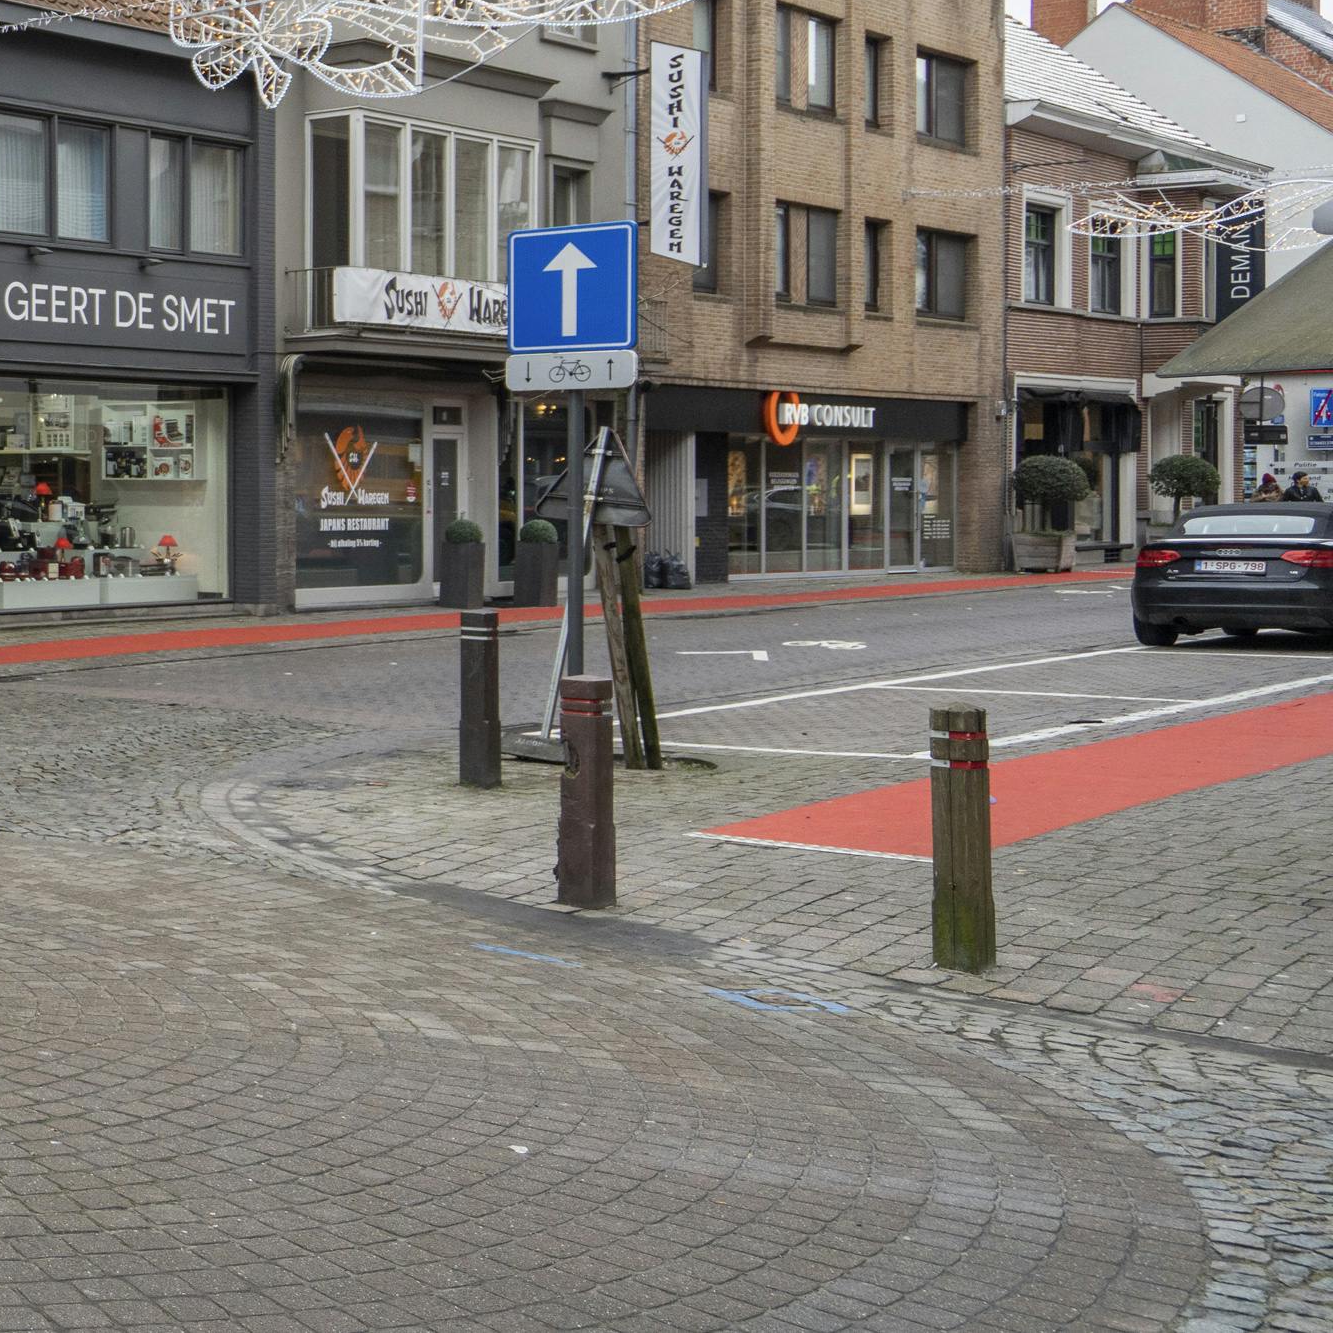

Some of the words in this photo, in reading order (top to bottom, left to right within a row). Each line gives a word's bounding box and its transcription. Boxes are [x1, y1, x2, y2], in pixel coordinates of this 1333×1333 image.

[668, 53, 684, 128] SUSHI
[668, 166, 688, 253] WAREGEM
[4, 281, 107, 326] GEERT
[114, 290, 154, 330] DE
[162, 294, 235, 335] SMET
[384, 276, 428, 320] SUSHI
[469, 286, 507, 325] WARE
[779, 403, 809, 426] RVB
[811, 404, 876, 427] CONSULT
[321, 486, 344, 509] SUSHI
[358, 488, 390, 506] WAREGEM
[320, 519, 346, 531] JAPANS
[347, 518, 390, 531] RESTAURANT
